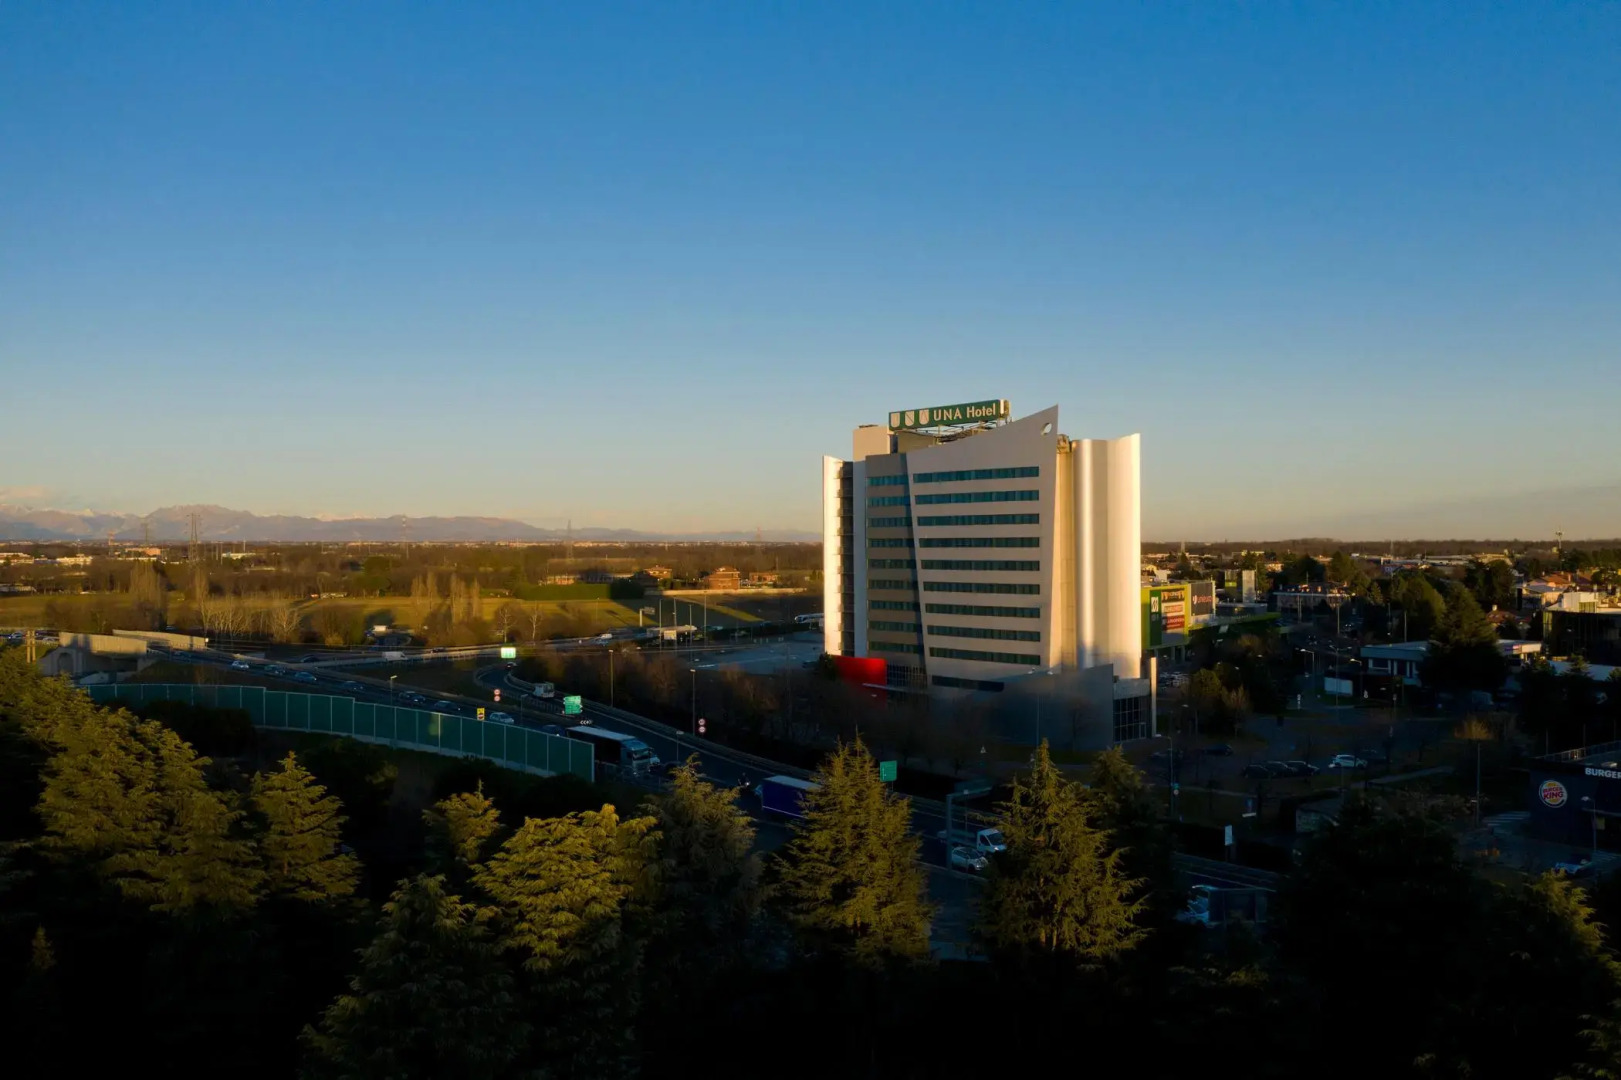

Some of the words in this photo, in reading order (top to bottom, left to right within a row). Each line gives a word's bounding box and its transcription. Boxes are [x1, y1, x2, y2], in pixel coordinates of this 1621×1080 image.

[933, 407, 962, 421] UNA
[966, 402, 996, 418] Hotel
[1543, 791, 1564, 800] KING
